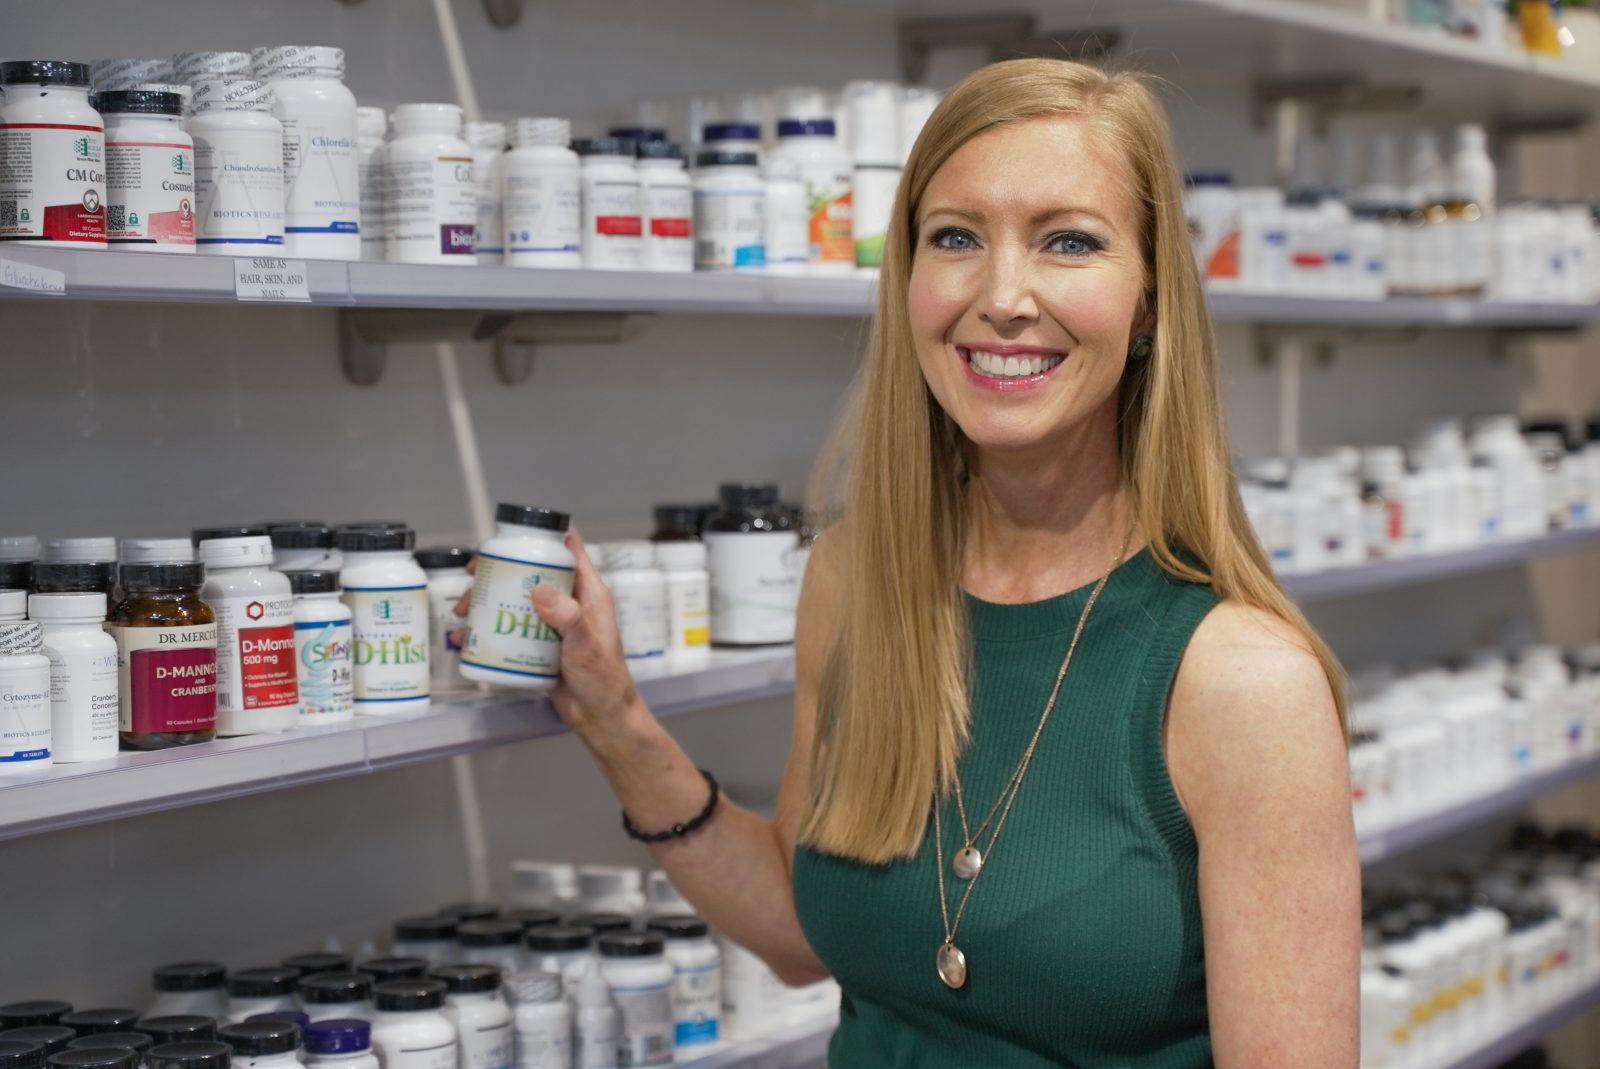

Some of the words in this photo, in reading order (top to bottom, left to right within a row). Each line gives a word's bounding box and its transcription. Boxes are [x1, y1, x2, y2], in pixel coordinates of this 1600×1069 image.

[66, 168, 88, 182] CM
[213, 210, 252, 219] BIOTICS
[69, 230, 88, 238] Dietary
[253, 258, 276, 269] SAME
[277, 258, 287, 269] AS
[240, 273, 264, 285] HAIR,
[265, 274, 286, 285] SKIN,
[287, 275, 304, 285] AND
[261, 289, 286, 298] NAILS
[181, 629, 218, 643] MERCOL
[242, 638, 295, 653] D-Manno
[243, 655, 261, 665] 500
[263, 655, 278, 665] mg
[156, 662, 218, 679] D-MANNO
[171, 685, 217, 697] CRANBERR
